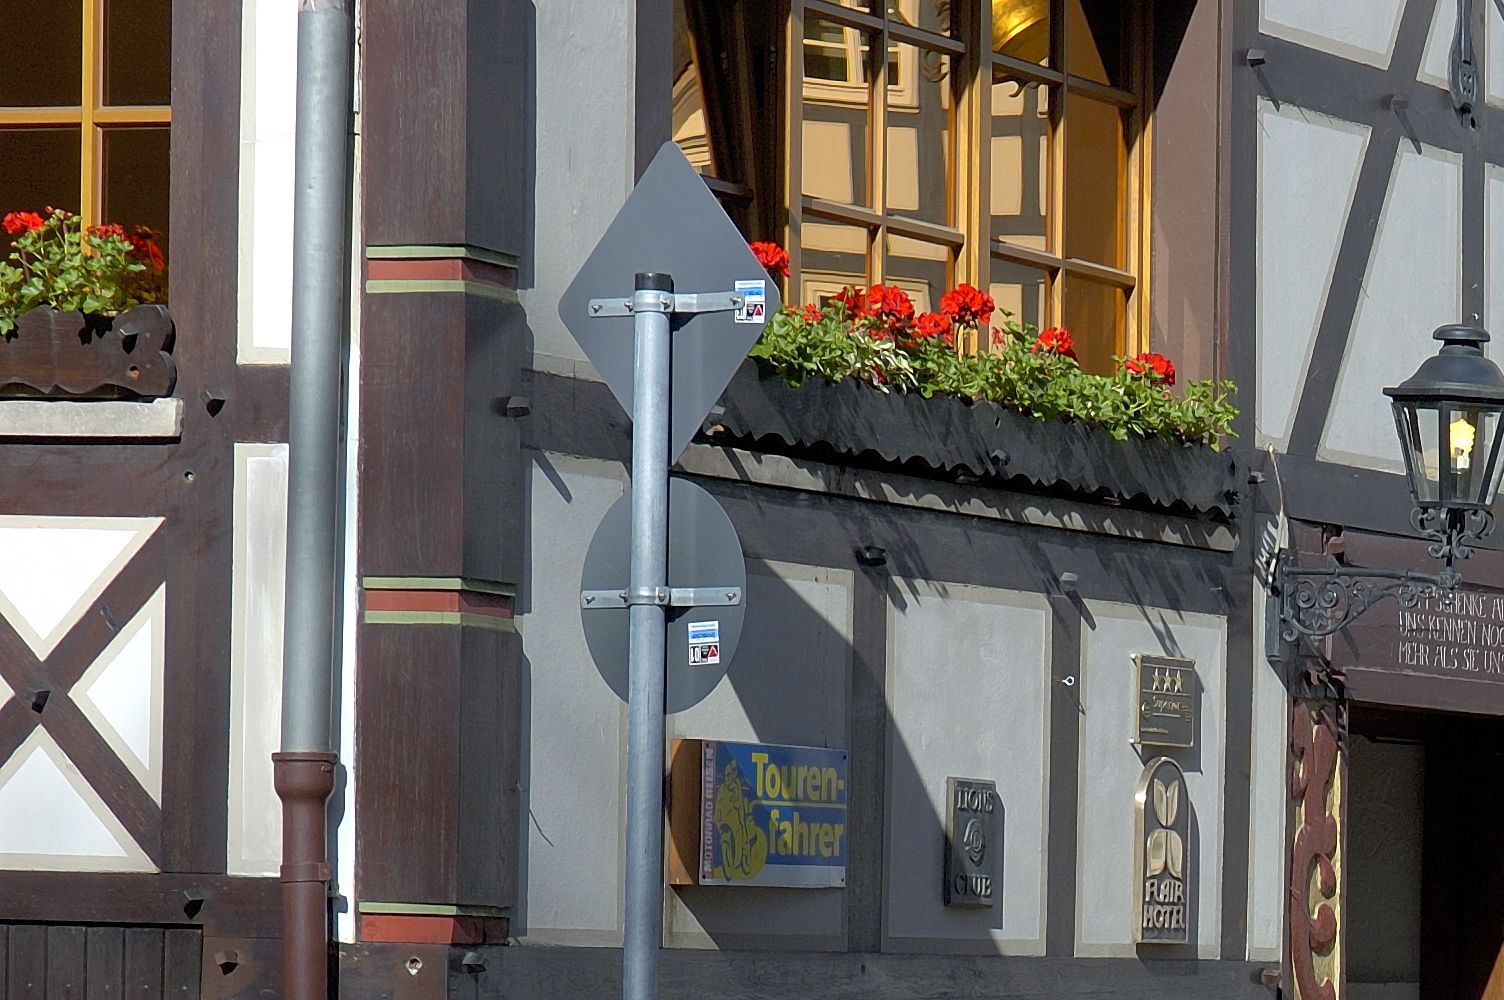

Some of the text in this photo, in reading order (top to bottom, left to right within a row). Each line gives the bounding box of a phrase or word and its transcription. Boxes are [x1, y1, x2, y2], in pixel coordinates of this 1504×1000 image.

[1399, 611, 1425, 638] UNS
[1428, 614, 1477, 645] KENNEN
[1399, 641, 1429, 667] MEHR
[1434, 645, 1458, 669] ALS
[1462, 647, 1480, 672] SIE
[752, 752, 844, 801] Touren-
[957, 787, 994, 814] LIONS
[769, 808, 844, 857] fahrer
[1145, 878, 1184, 903] FLAIR
[1142, 904, 1186, 930] HOTEL
